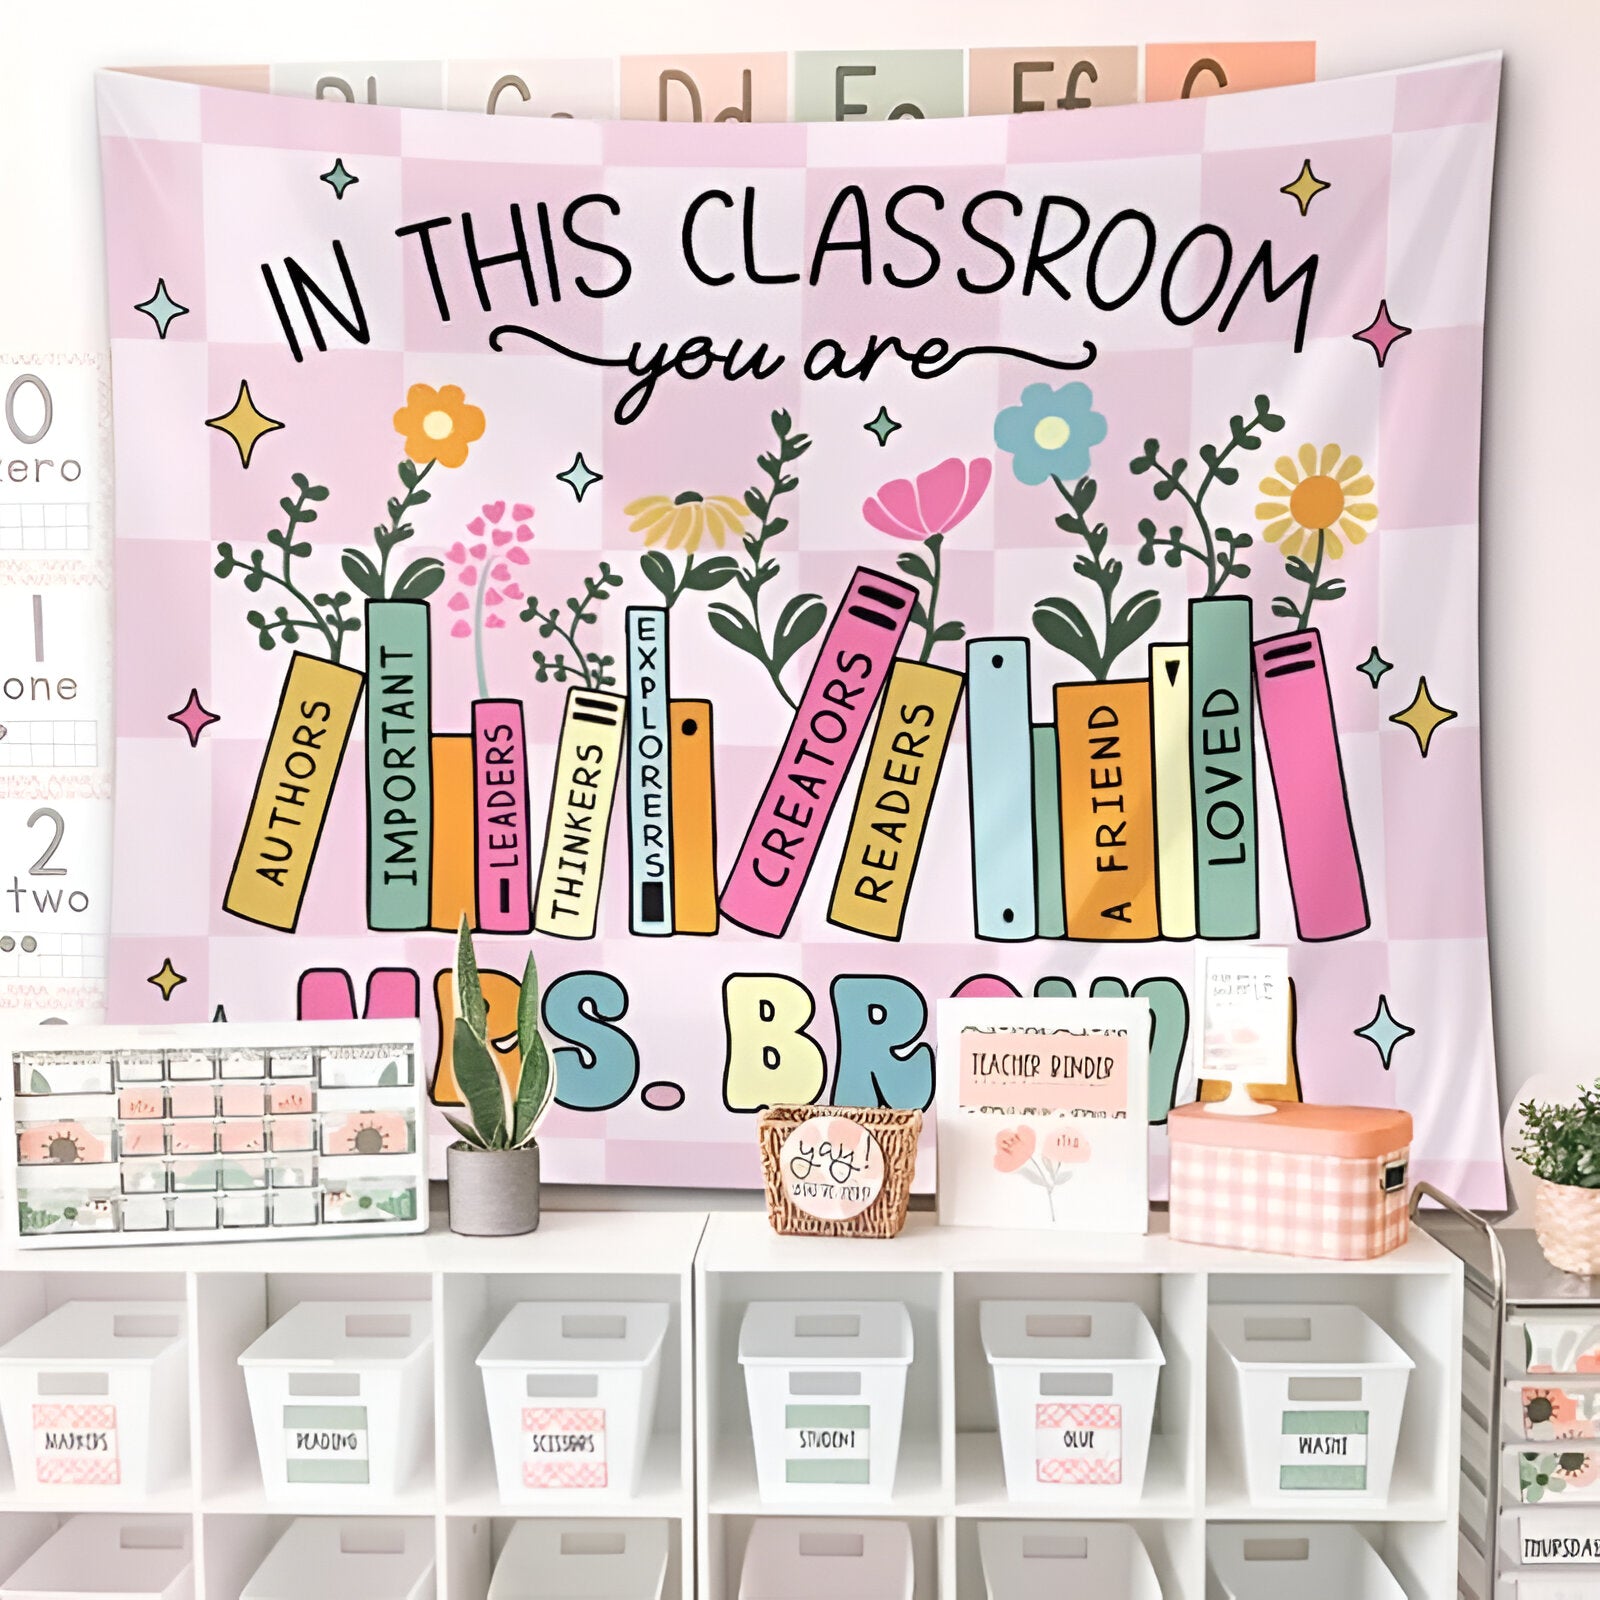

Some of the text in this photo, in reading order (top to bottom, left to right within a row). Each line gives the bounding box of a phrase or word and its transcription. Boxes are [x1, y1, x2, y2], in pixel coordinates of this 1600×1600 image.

[261, 185, 1319, 362] IN THIS CLASSROOM
[0, 458, 81, 483] ero
[3, 676, 78, 701] one
[380, 645, 418, 886] IMPORTANT
[637, 617, 665, 878] EXPLORERS
[753, 650, 872, 888] CREATORS
[1202, 688, 1246, 866] LOVED
[27, 807, 68, 876] 2
[256, 701, 330, 887] AUTHORS
[484, 724, 519, 868] LEADERS
[551, 744, 603, 920] THINKERS
[854, 704, 934, 904] READERS
[1088, 705, 1132, 923] A FRIEND
[6, 875, 89, 913] two
[790, 1134, 871, 1184] yay!
